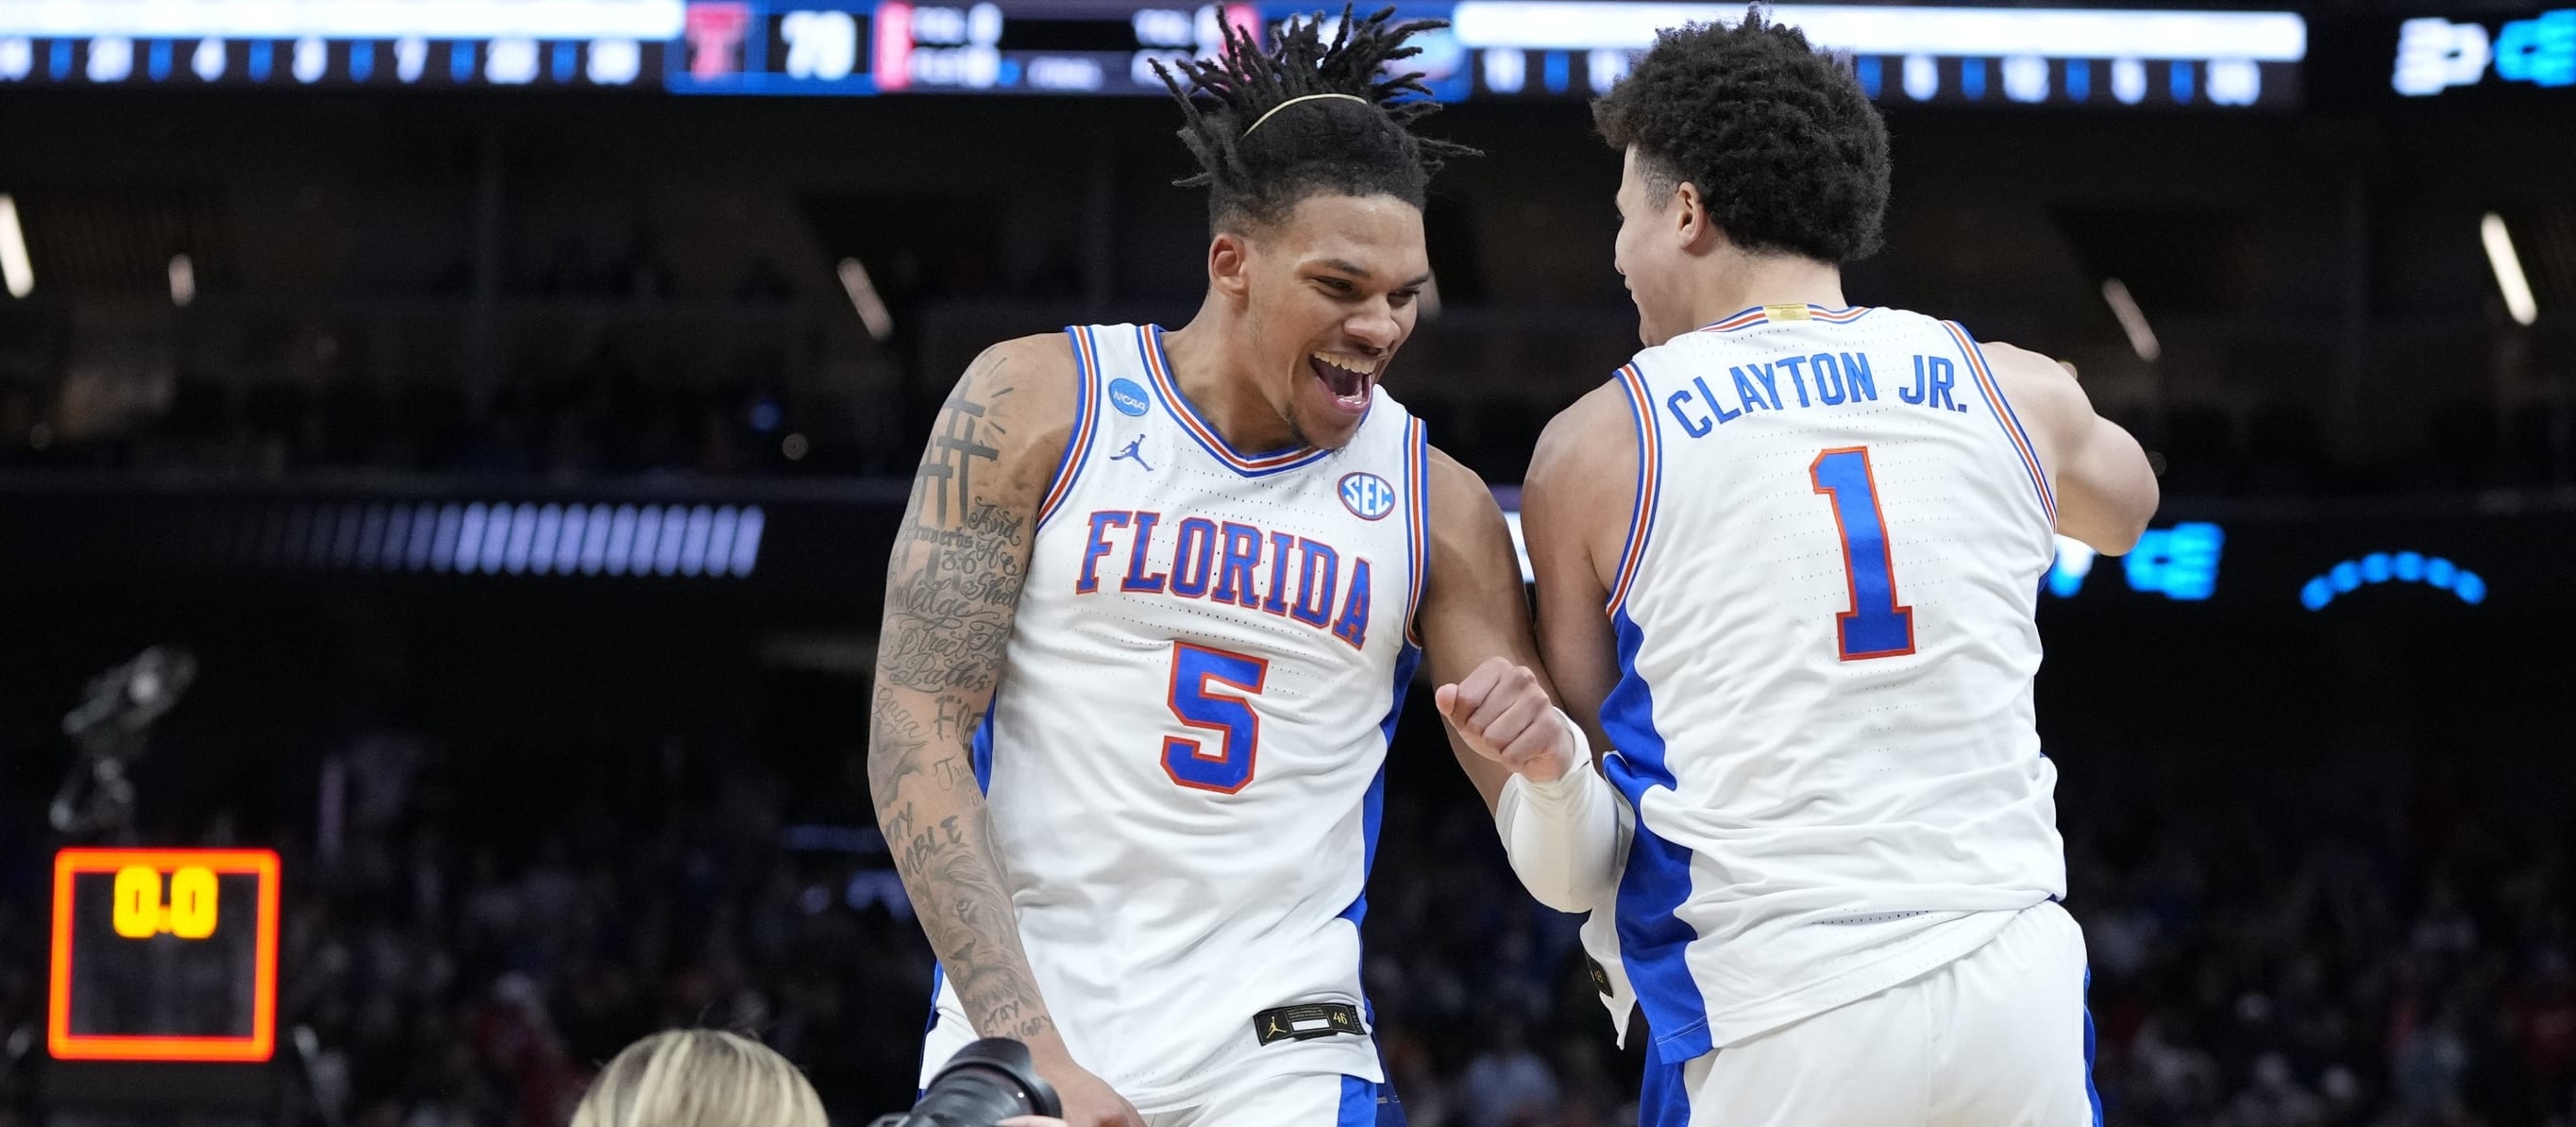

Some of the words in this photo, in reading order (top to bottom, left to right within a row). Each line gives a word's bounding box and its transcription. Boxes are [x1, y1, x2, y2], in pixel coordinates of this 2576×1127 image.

[1114, 390, 1146, 412] NCAA
[1666, 352, 1877, 438] CLAYTON
[1898, 354, 1967, 412] JR.
[1343, 474, 1391, 516] SEC
[1075, 511, 1372, 650] FLORIDA
[1809, 446, 1916, 662] 1
[1160, 641, 1269, 795] 5
[113, 866, 218, 939] 0.0
[1333, 1012, 1348, 1025] 46
